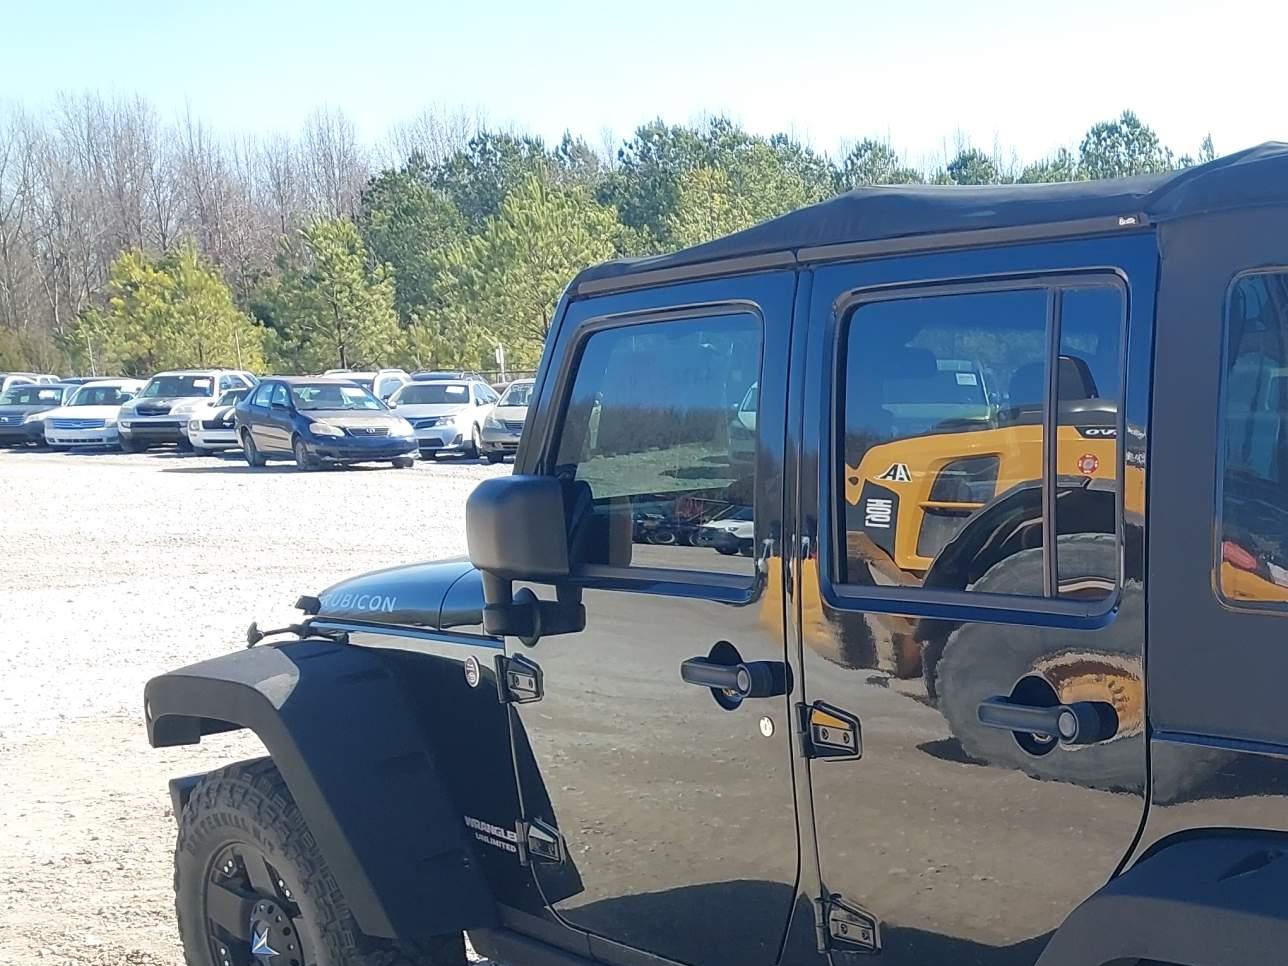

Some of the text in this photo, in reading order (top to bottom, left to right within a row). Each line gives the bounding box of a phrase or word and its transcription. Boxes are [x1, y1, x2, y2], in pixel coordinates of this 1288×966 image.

[320, 592, 398, 613] RUBICON
[463, 815, 518, 843] WRANGLE
[475, 831, 518, 854] UNLIMITED
